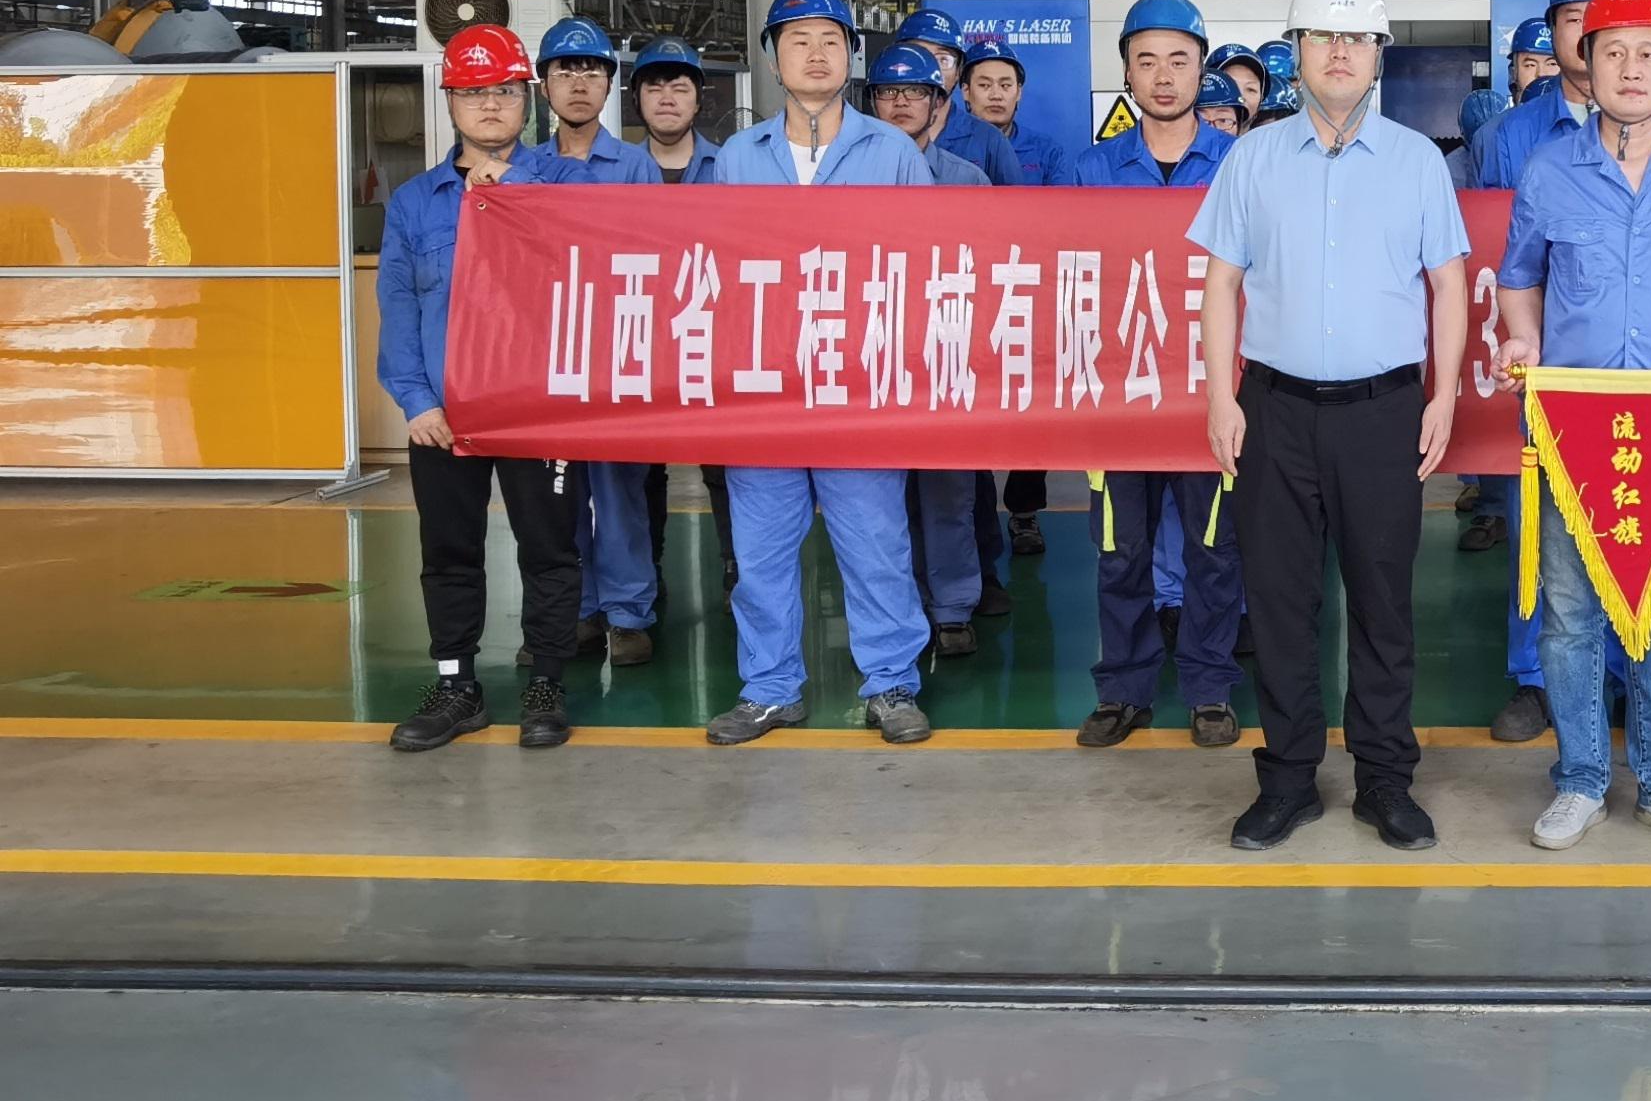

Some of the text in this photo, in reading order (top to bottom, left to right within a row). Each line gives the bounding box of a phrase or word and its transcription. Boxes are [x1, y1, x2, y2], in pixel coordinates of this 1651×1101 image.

[1018, 18, 1072, 33] LASER
[1610, 411, 1643, 546] 流动红旗
